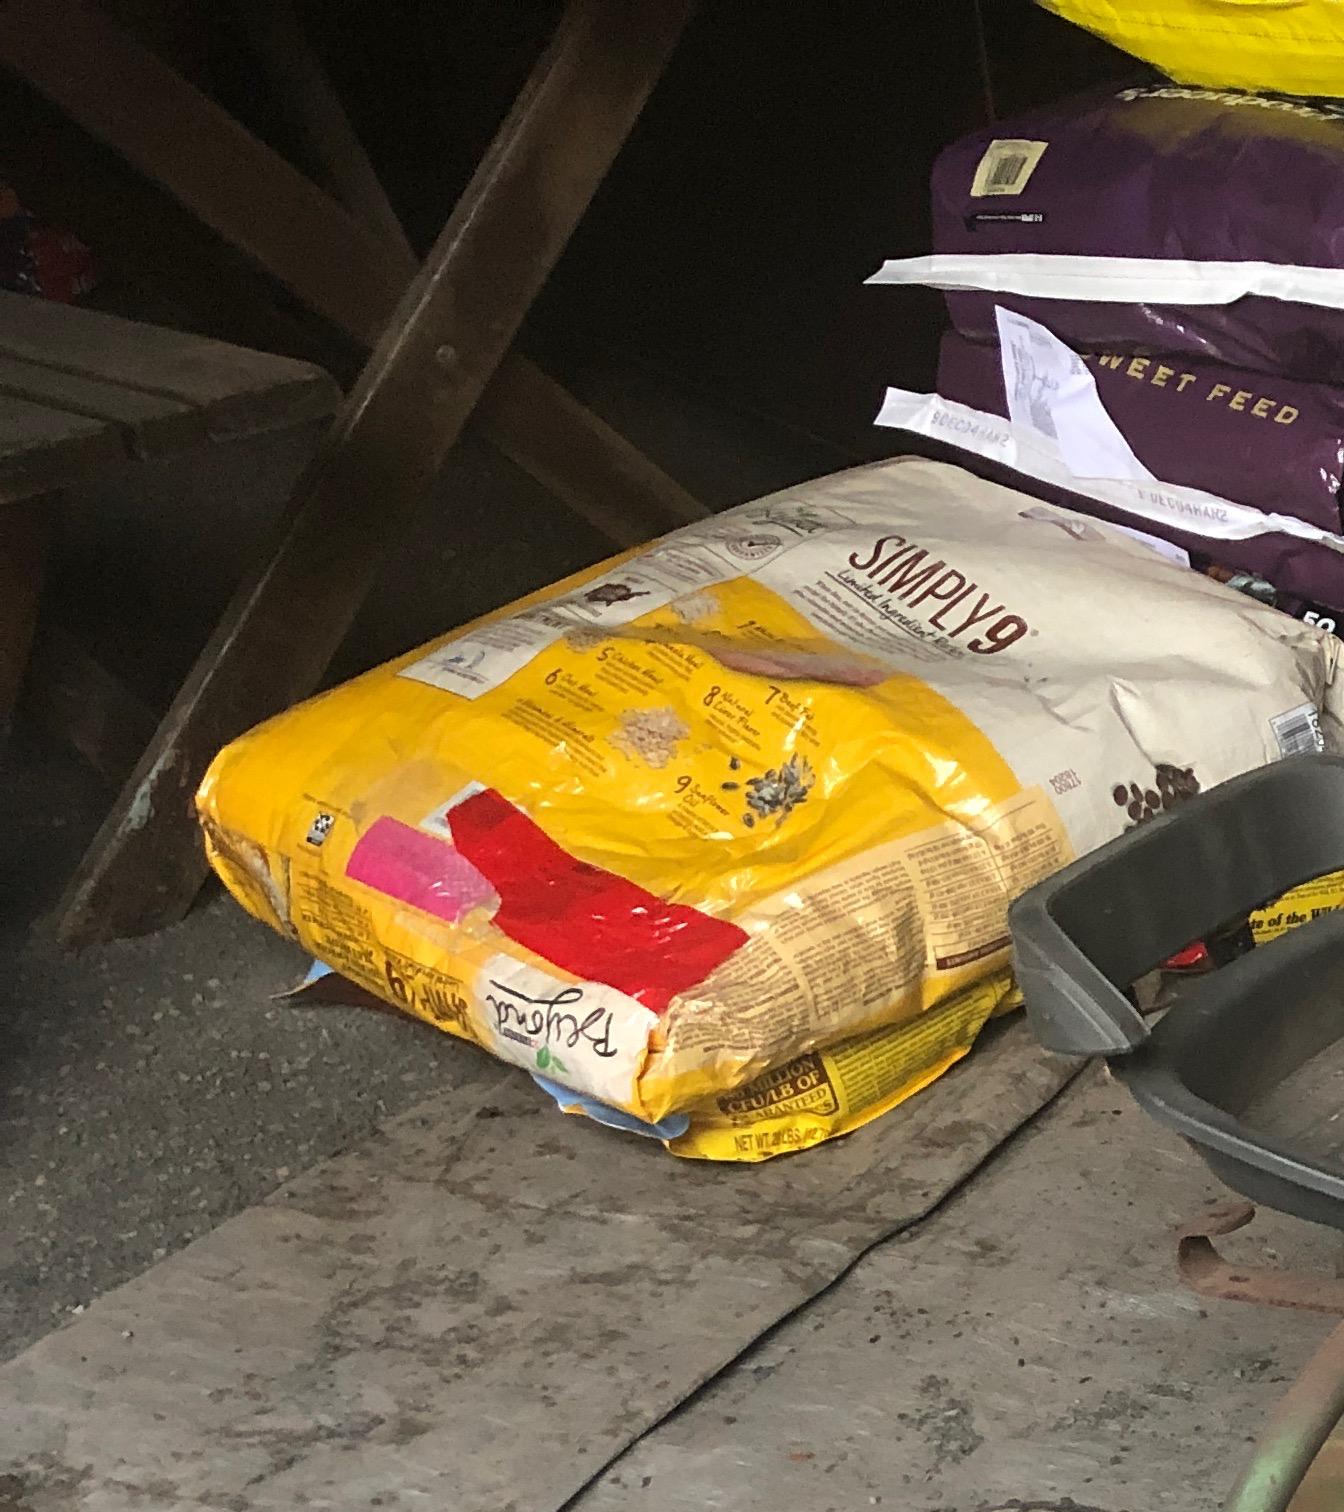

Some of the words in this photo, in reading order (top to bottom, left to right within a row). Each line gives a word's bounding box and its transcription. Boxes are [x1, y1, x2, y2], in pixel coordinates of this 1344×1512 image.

[1084, 354, 1197, 393] WEET
[1206, 383, 1299, 425] FEED
[597, 646, 615, 662] 5
[545, 668, 562, 686] 6
[703, 685, 721, 706] 8
[765, 684, 781, 705] 7
[674, 775, 693, 794] 9
[484, 979, 619, 1058] Beyond
[796, 1070, 821, 1090] OF
[734, 1133, 754, 1153] NET
